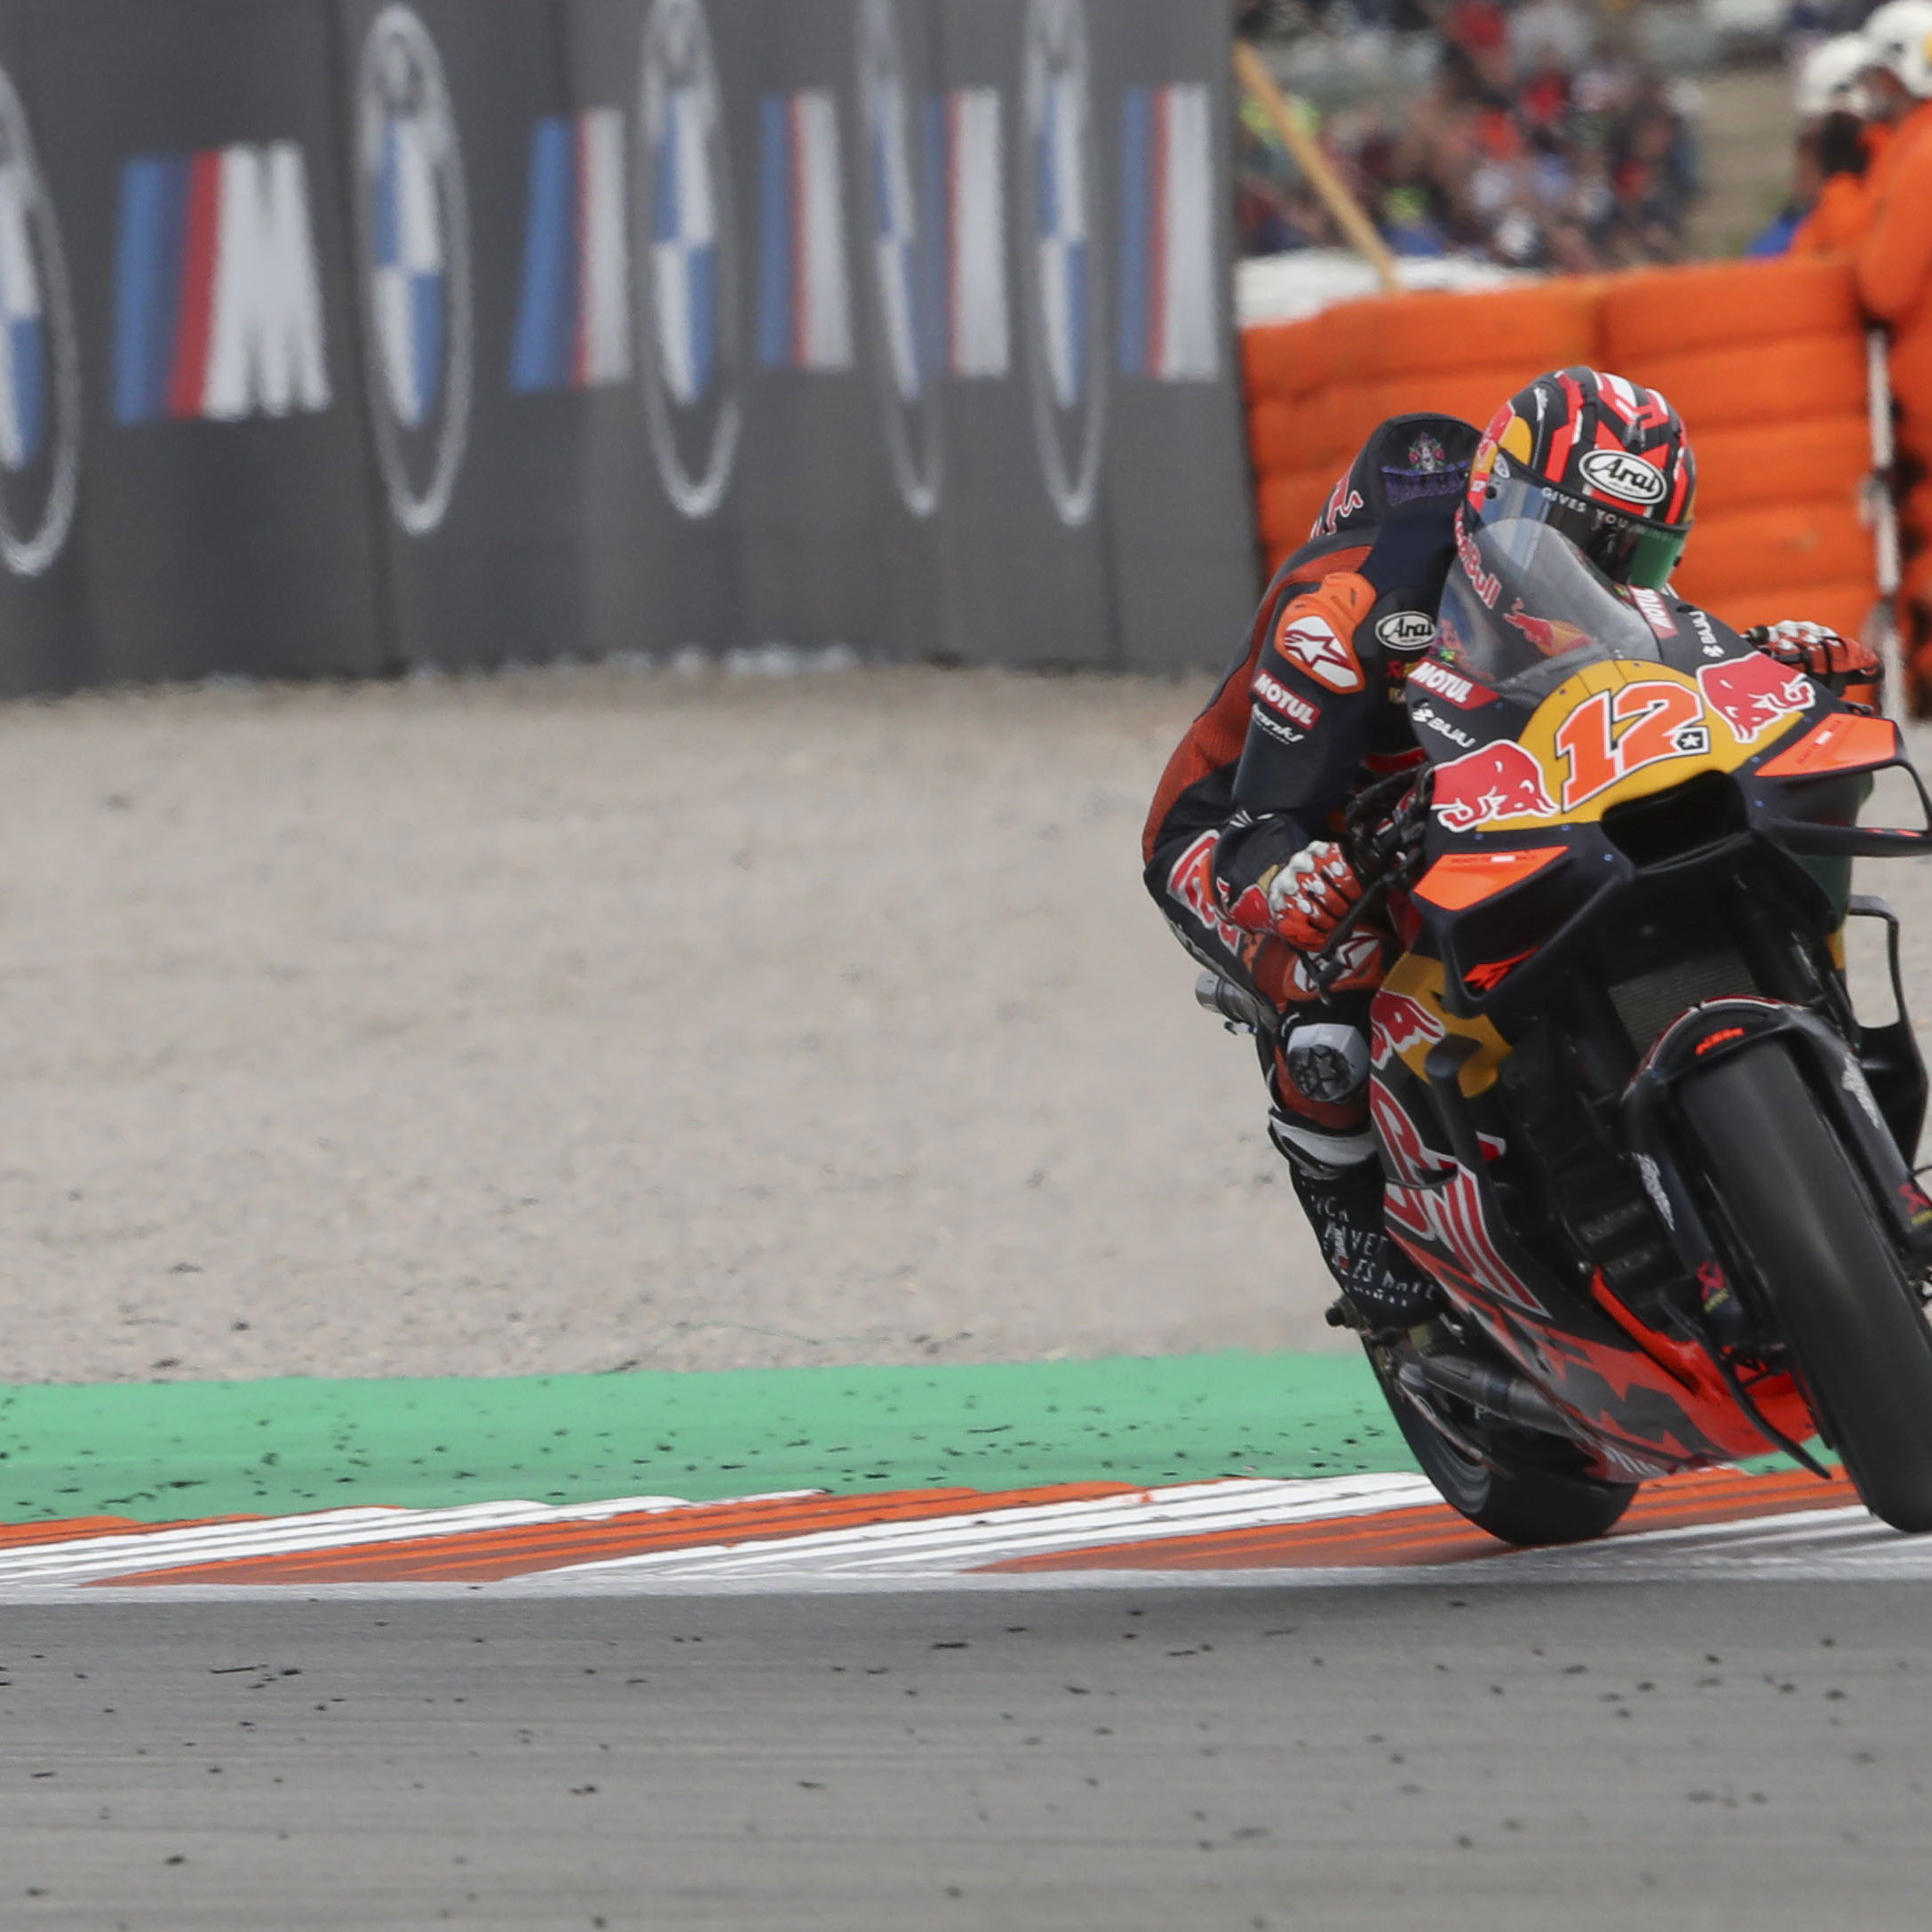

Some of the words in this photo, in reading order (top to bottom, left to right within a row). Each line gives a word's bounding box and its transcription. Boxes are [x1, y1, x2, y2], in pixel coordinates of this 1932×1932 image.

[1587, 457, 1656, 492] Arai
[1541, 486, 1587, 513] GIVES
[1594, 507, 1629, 530] YOU
[1383, 616, 1432, 640] Arai
[1253, 673, 1315, 726] MOTUL
[1409, 661, 1474, 704] MOTUL
[1554, 680, 1705, 814] 12
